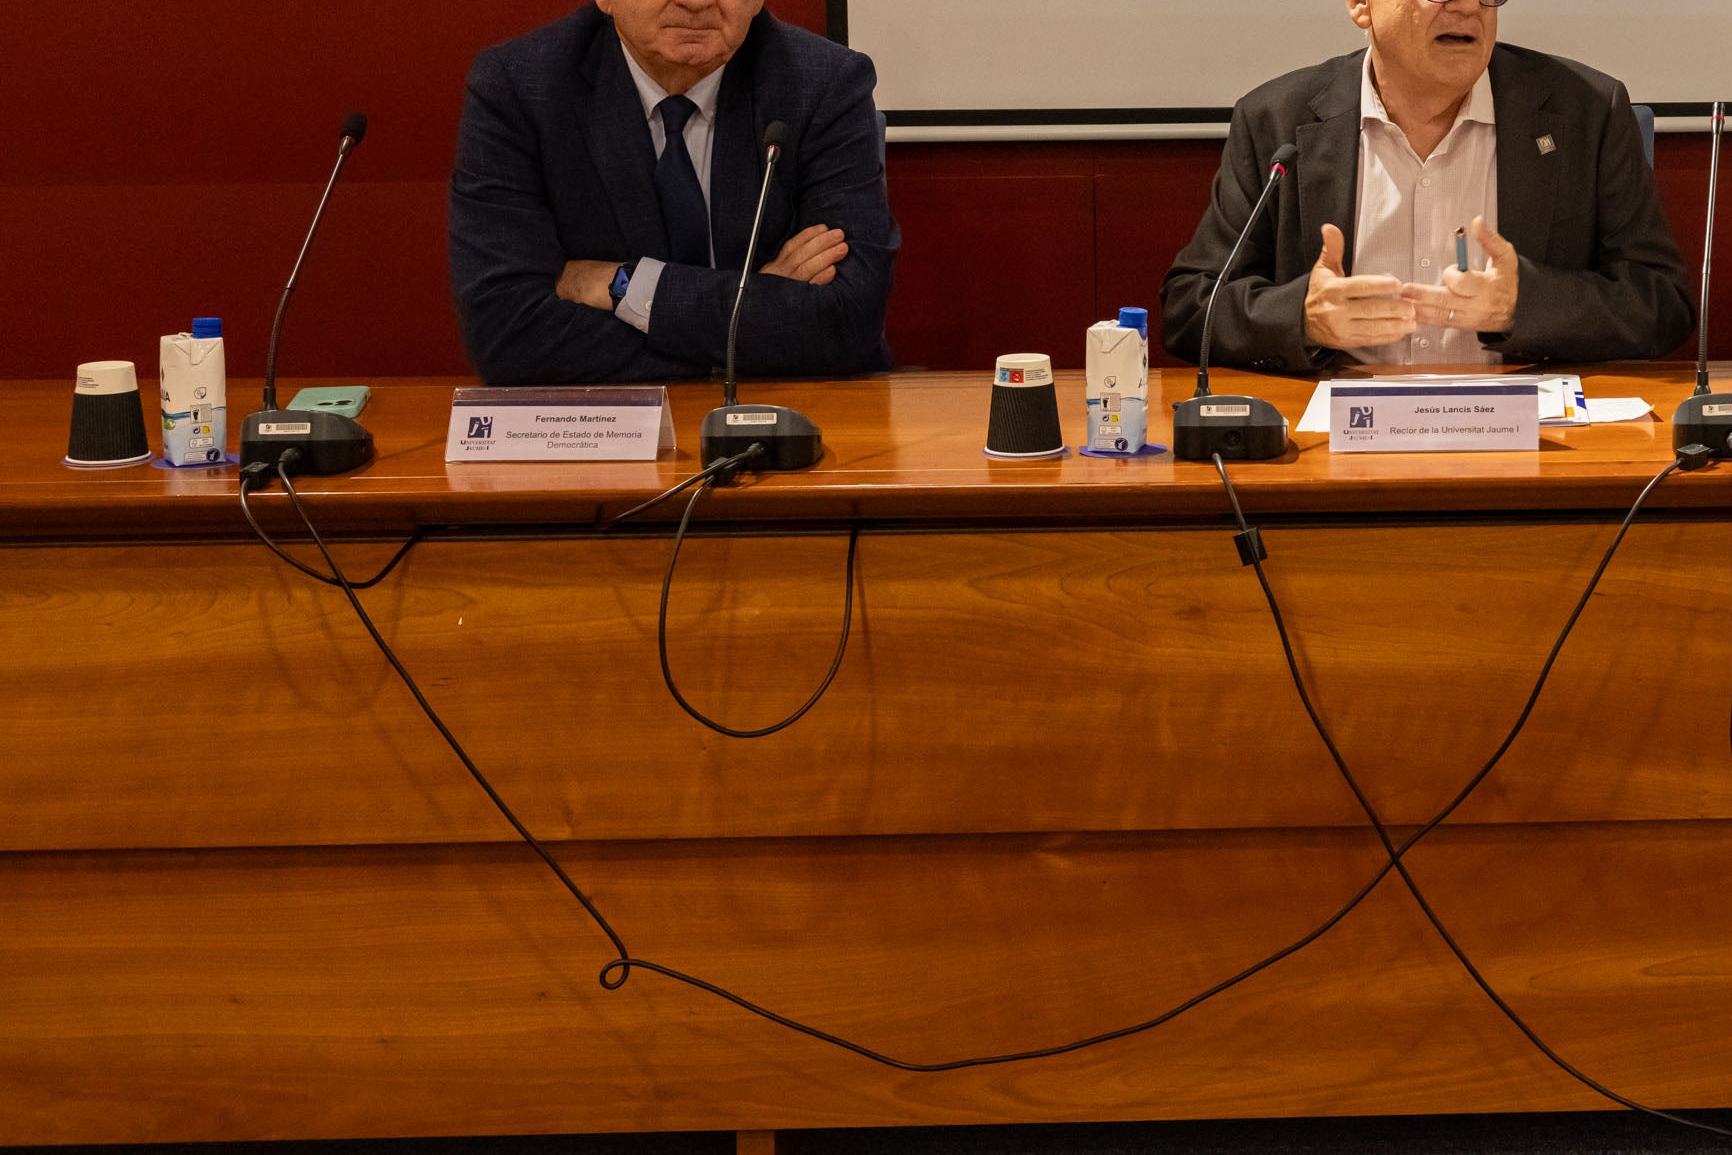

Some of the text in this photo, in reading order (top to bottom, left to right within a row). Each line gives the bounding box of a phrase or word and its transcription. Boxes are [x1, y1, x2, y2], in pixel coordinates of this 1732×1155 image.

[1414, 405, 1495, 414] Jesús Lancis Sáez
[535, 415, 577, 423] Fernando
[505, 430, 642, 439] Secretario de Estado de Memoria
[1389, 427, 1417, 435] Rector
[1431, 426, 1439, 434] la
[1441, 426, 1485, 434] Universitat
[1486, 425, 1515, 434] Jaume
